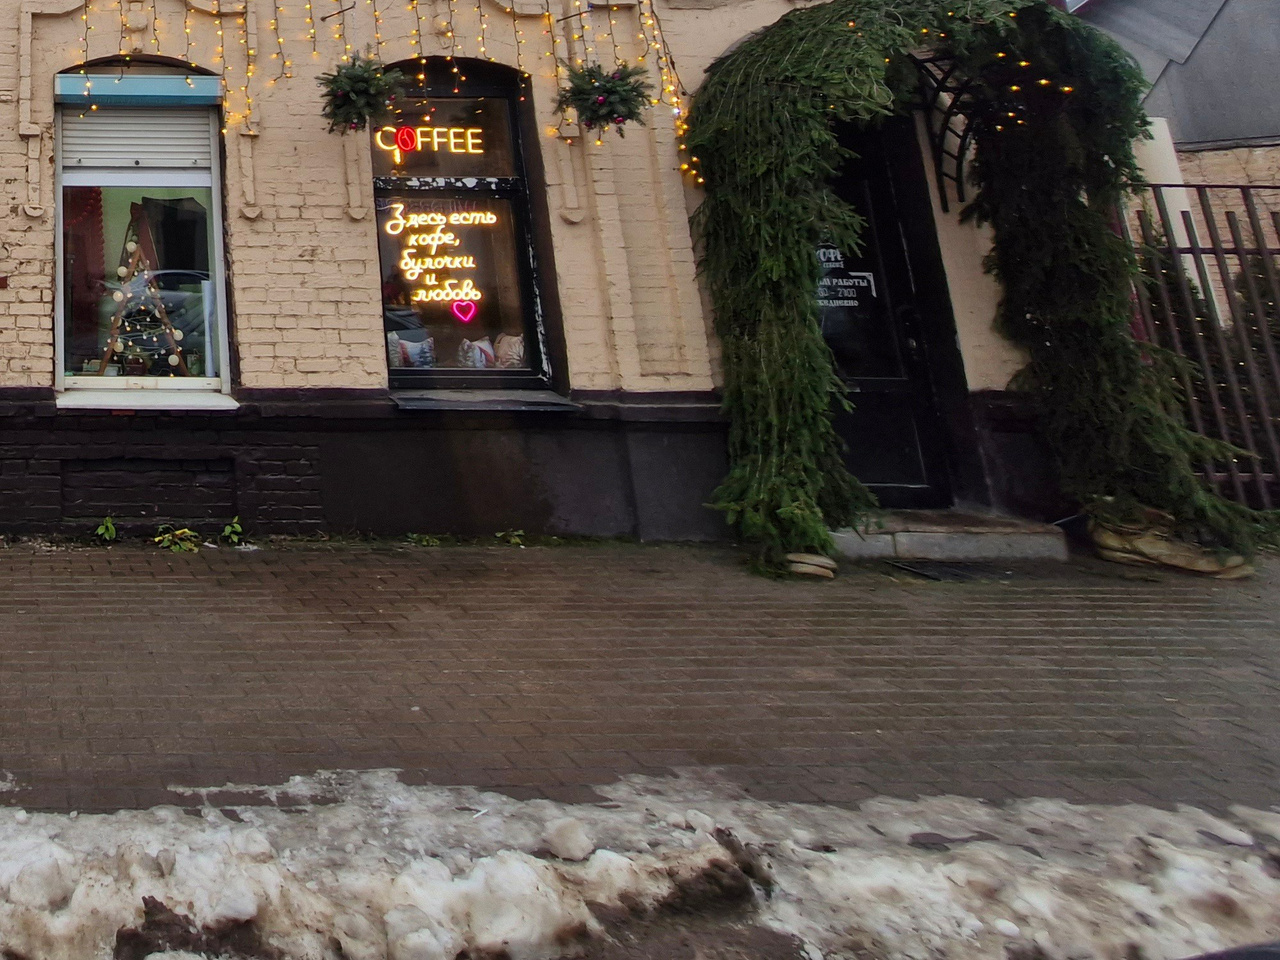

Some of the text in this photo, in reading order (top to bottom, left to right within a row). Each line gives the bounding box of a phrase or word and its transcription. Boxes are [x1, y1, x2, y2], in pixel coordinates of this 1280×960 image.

[376, 126, 484, 159] COFFEE
[385, 203, 497, 235] Здесь есть
[408, 226, 460, 255] кофе,
[400, 249, 476, 281] булочки
[425, 274, 439, 285] и
[412, 280, 482, 301] любовь
[832, 278, 868, 286] РАБОТЫ
